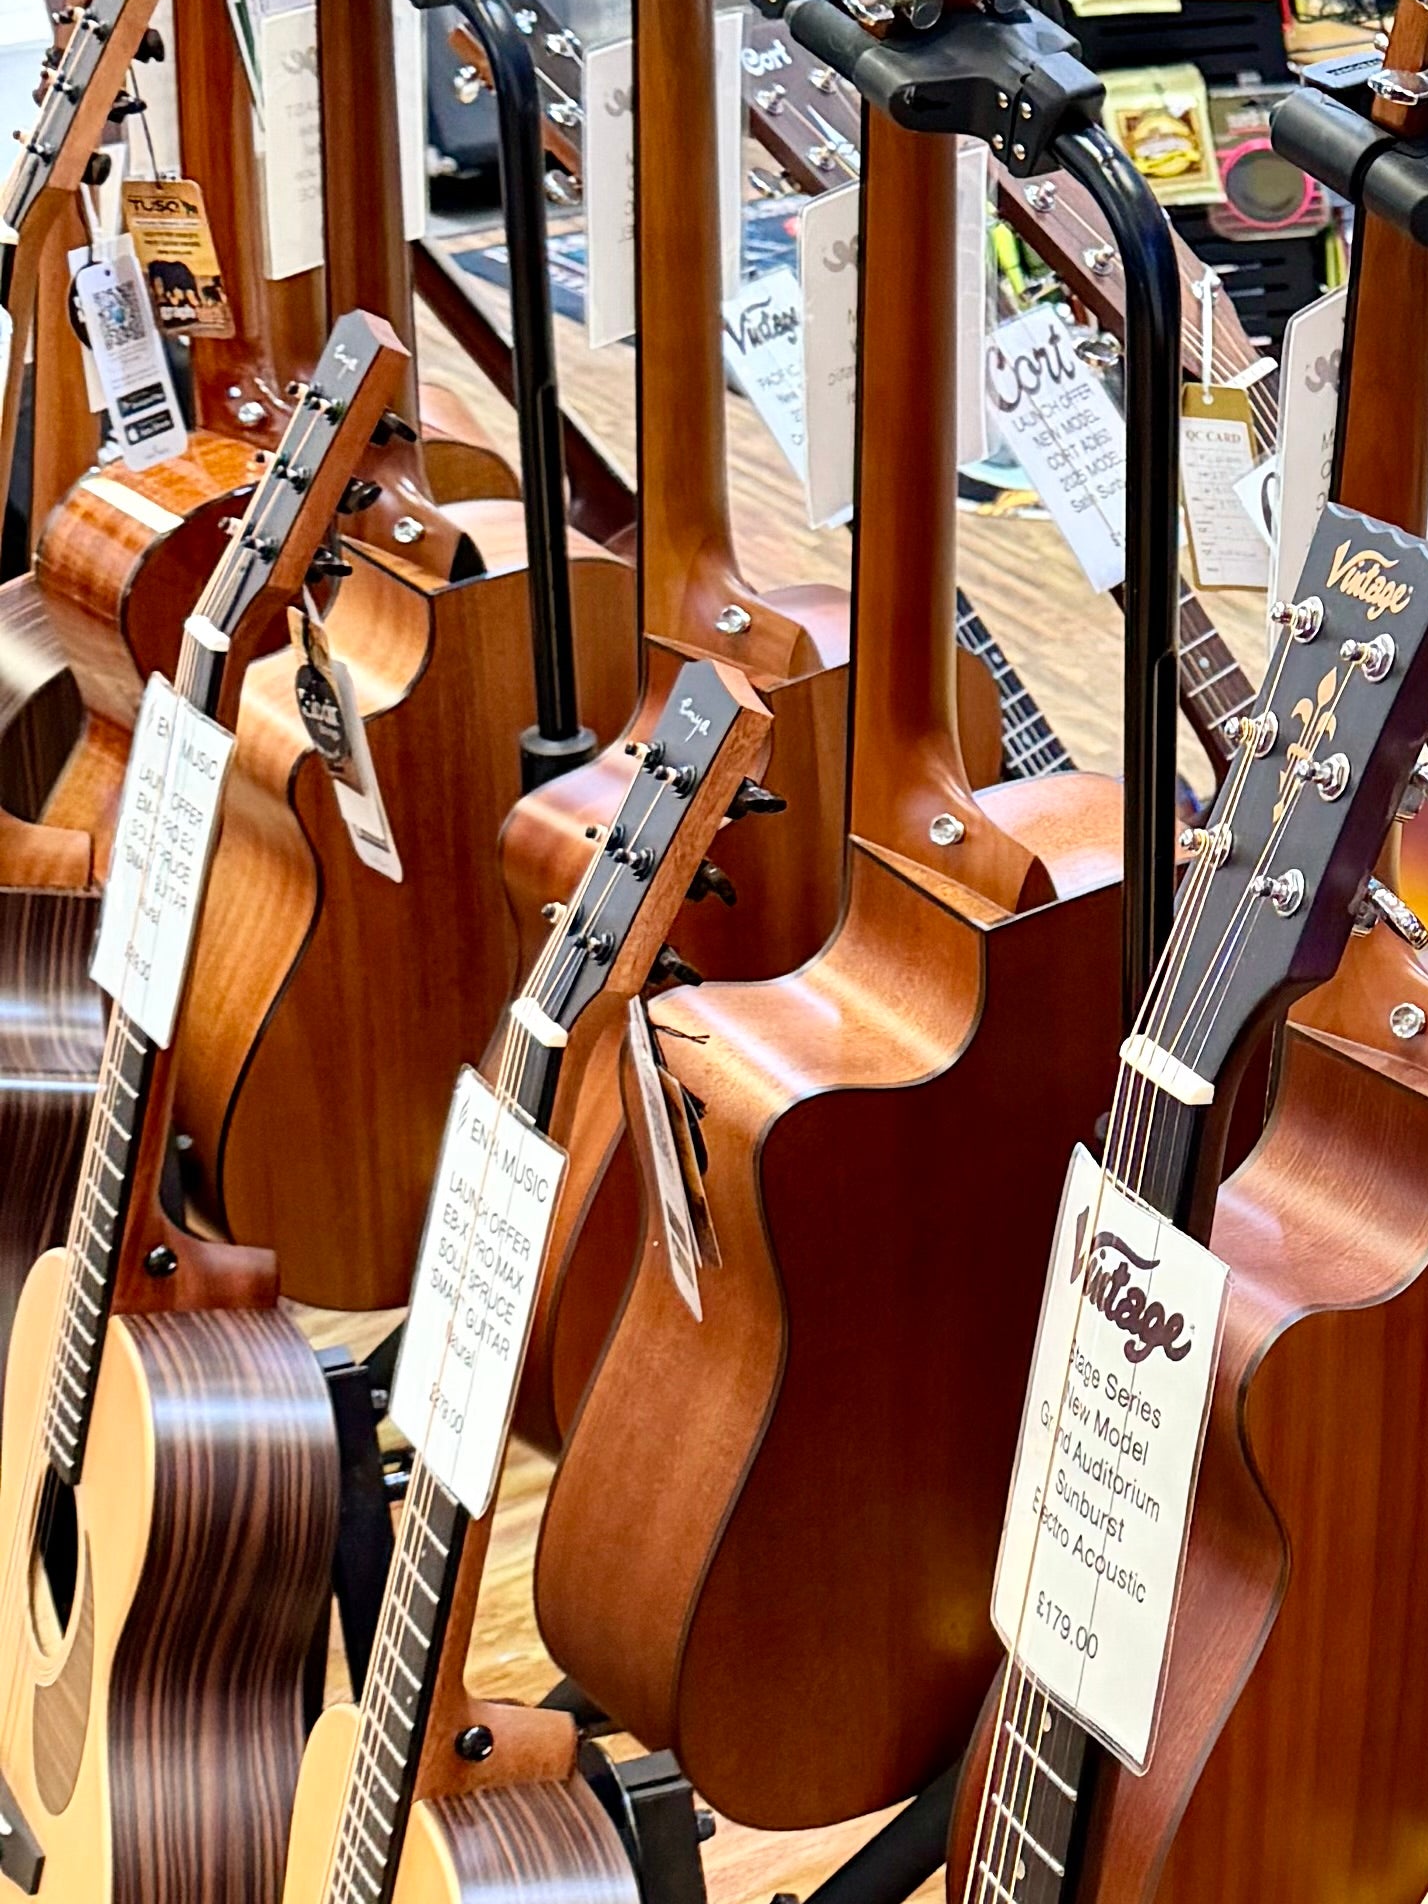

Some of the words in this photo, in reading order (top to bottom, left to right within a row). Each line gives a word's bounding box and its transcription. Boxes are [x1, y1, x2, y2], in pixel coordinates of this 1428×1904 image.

[985, 331, 1076, 413] Cort
[1011, 398, 1060, 435] LAUNCH
[1059, 383, 1094, 413] OFFER
[1031, 425, 1062, 450] NEW
[1062, 409, 1102, 437] MODEL
[1184, 427, 1202, 445] QC
[1204, 429, 1243, 446] CARD
[1046, 449, 1079, 473] CORT
[1326, 539, 1412, 621] Vintage
[500, 1149, 550, 1205] MUSIC
[489, 1206, 533, 1263] OFFER
[1069, 1204, 1196, 1364] Vintage
[465, 1305, 512, 1363] GUITAR
[1103, 1367, 1164, 1431] Series
[1091, 1411, 1150, 1468] Model
[1054, 1468, 1127, 1545] Sunburst
[1071, 1438, 1162, 1525] Auditorium
[1071, 1528, 1148, 1605] Acoustic
[1034, 1589, 1101, 1662] £179.00
